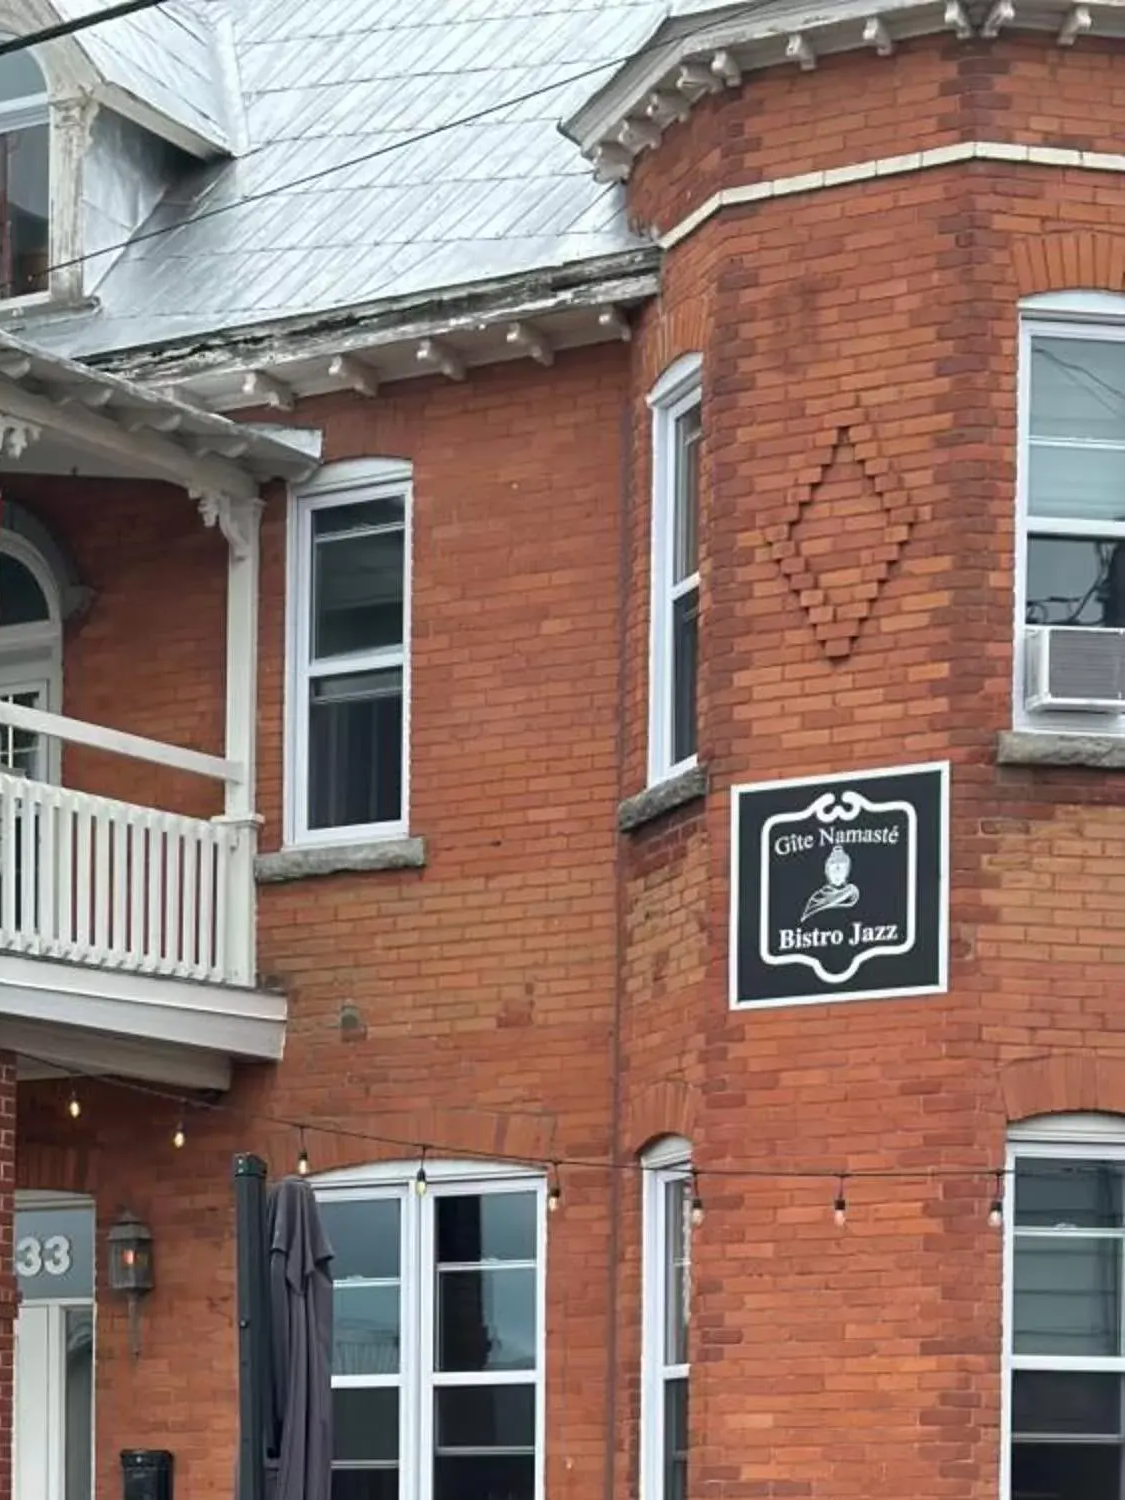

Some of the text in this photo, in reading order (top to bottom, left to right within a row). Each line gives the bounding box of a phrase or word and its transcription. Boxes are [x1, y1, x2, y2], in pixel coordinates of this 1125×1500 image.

[819, 825, 900, 846] Namasté
[779, 921, 898, 950] Bistro Jazz
